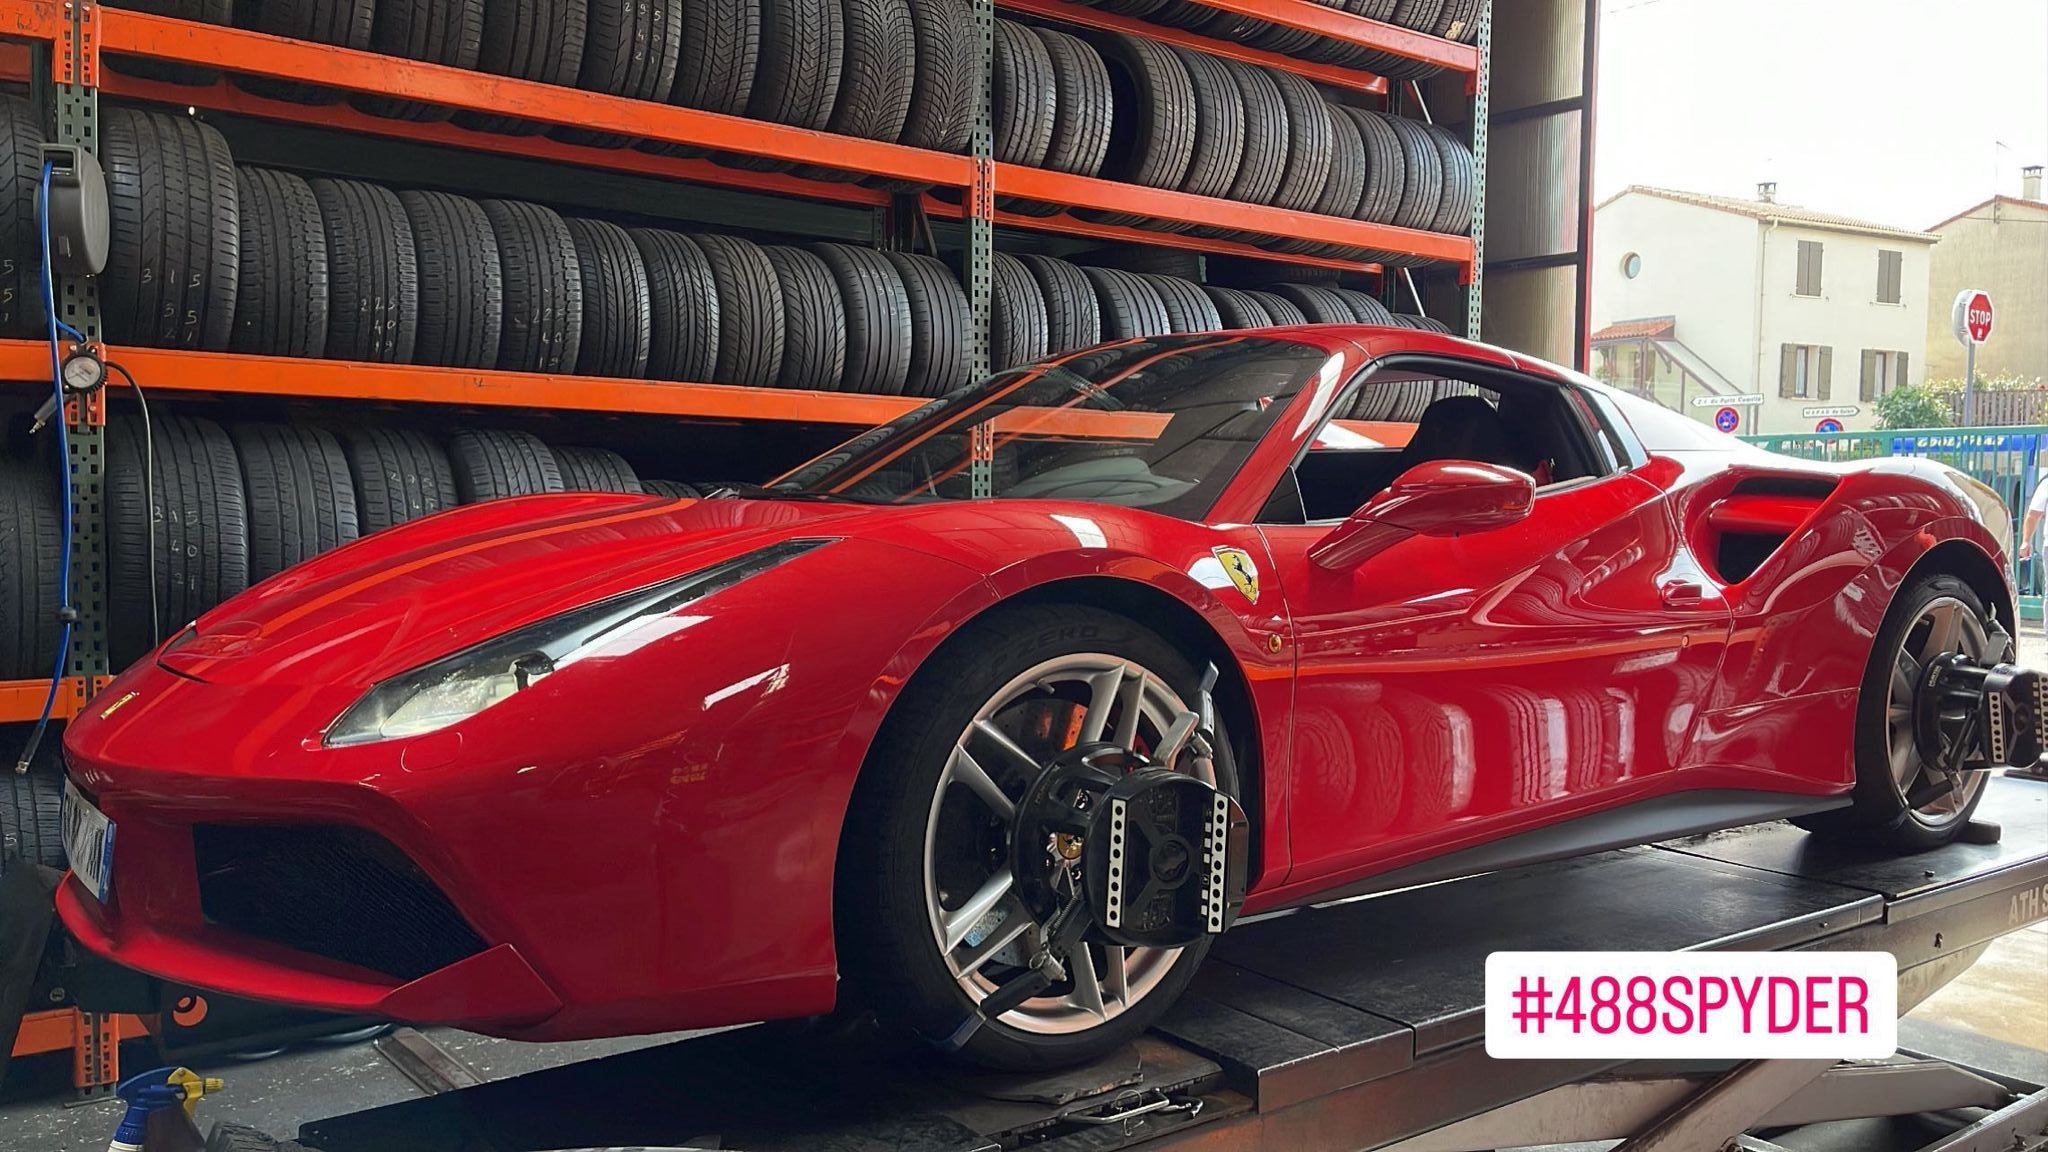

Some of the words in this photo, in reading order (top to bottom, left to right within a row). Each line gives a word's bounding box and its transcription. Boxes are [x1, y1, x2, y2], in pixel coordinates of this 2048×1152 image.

[625, 2, 661, 21] 295
[638, 29, 660, 41] 40
[635, 51, 655, 64] 21
[141, 268, 201, 288] 315
[1970, 309, 1991, 326] STOP
[374, 320, 397, 335] 40
[152, 506, 198, 526] 315
[171, 539, 198, 557] 40
